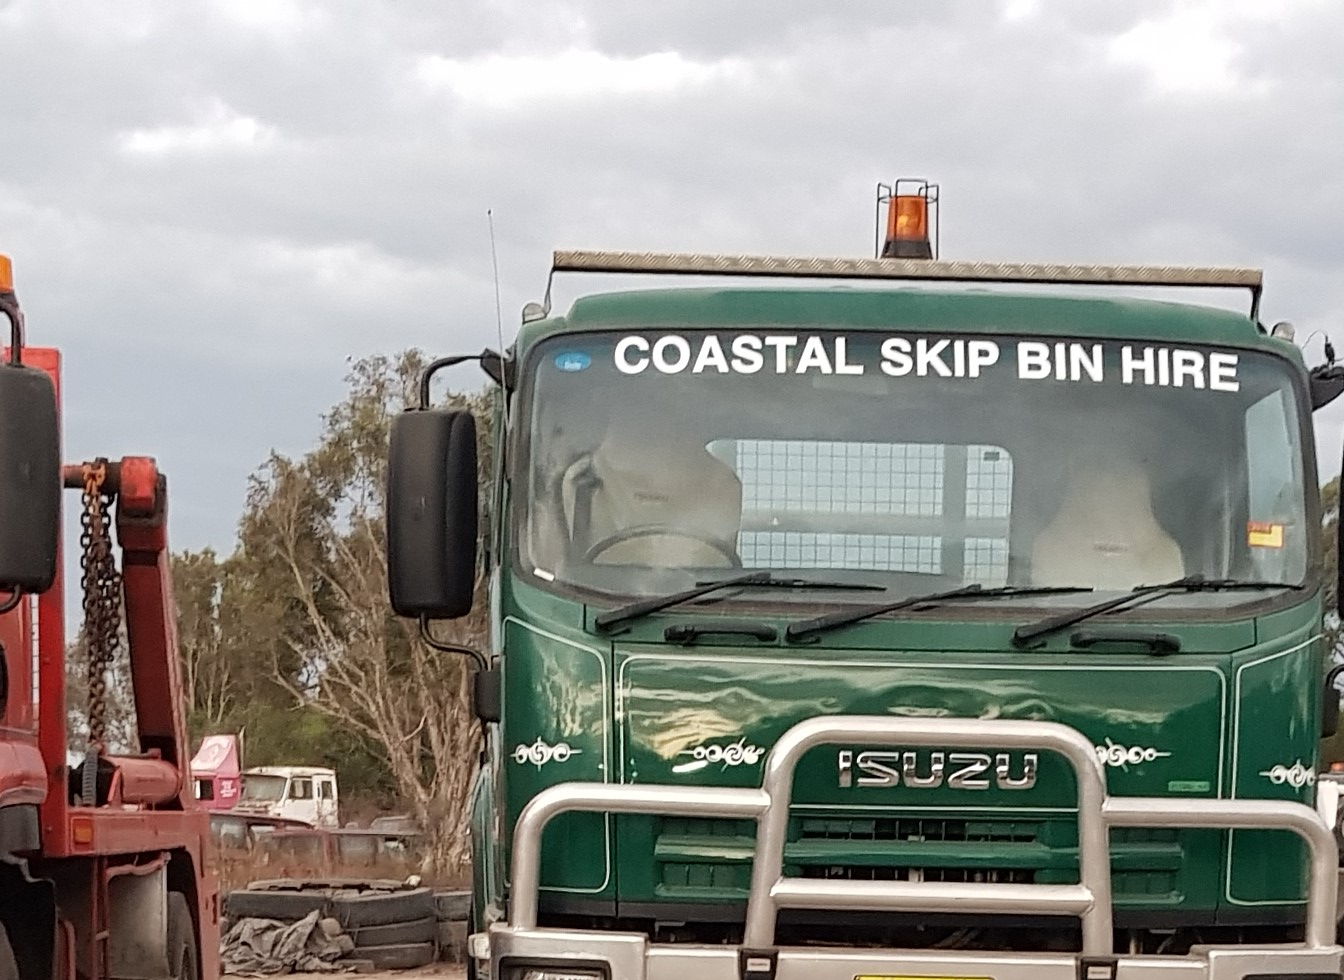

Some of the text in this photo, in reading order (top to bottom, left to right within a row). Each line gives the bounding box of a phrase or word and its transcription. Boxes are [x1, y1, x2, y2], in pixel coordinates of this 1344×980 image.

[613, 335, 1240, 392] COASTAL SKIP BIN HIRE
[838, 750, 1038, 790] ISUZU
